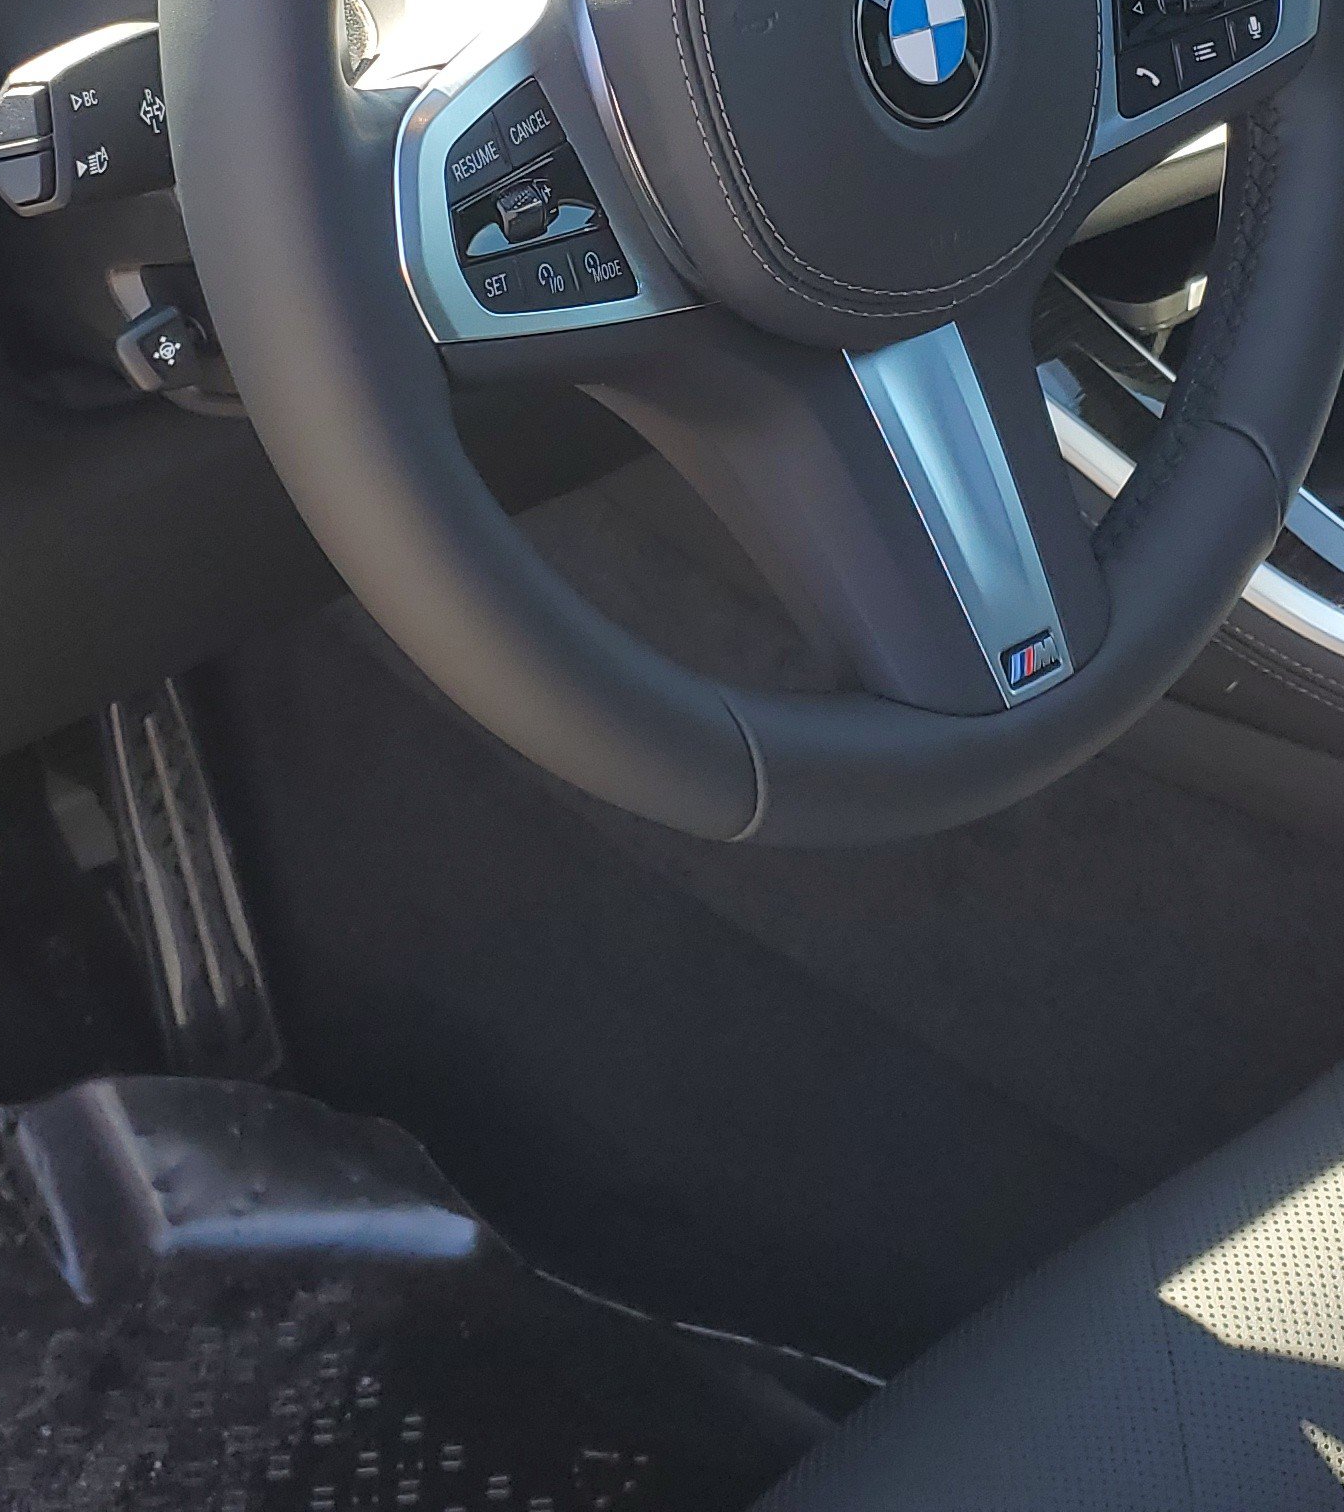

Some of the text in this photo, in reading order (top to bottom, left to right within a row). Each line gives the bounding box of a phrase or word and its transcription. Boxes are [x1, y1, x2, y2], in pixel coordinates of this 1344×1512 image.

[82, 89, 98, 107] BC
[145, 89, 154, 103] R
[152, 119, 160, 134] L
[509, 109, 551, 145] CANCEL
[452, 141, 500, 181] RESUME
[593, 260, 623, 283] MODE
[485, 273, 509, 298] SET
